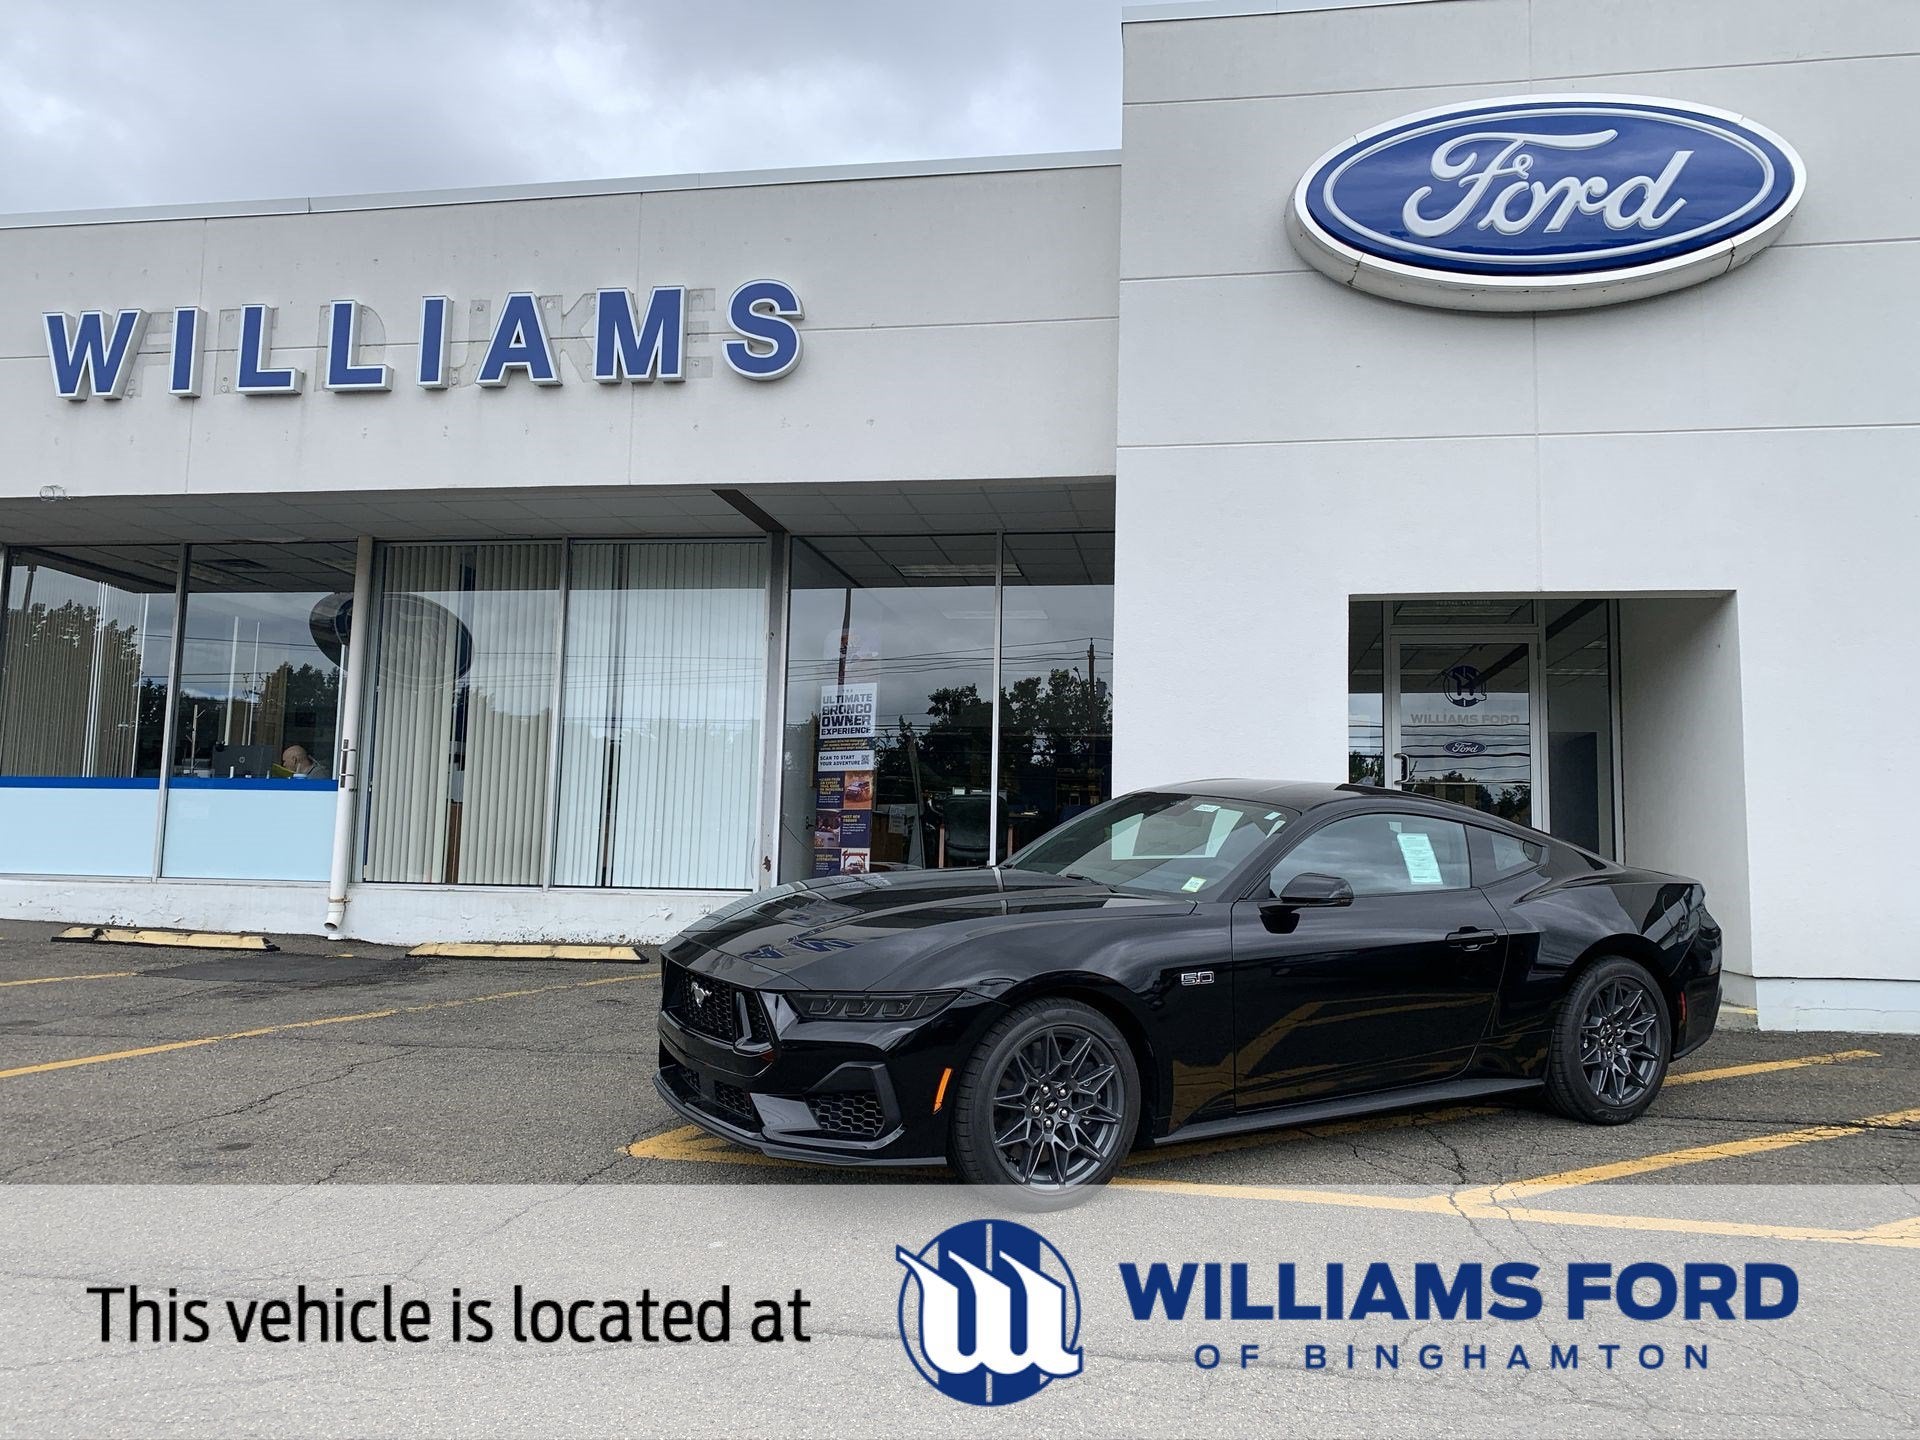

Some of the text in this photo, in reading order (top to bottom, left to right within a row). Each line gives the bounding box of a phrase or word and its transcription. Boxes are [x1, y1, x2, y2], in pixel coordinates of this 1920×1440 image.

[1402, 129, 1695, 237] Ford
[42, 279, 806, 401] WILLIAMS
[822, 694, 872, 704] ULTIMATE
[822, 703, 872, 715] BRONCO
[821, 714, 871, 727] OWNER
[1410, 714, 1520, 724] WILLIAMS FORD
[821, 727, 871, 735] EXPERIENCE
[1452, 742, 1478, 753] Ford
[1181, 971, 1215, 986] 5.0
